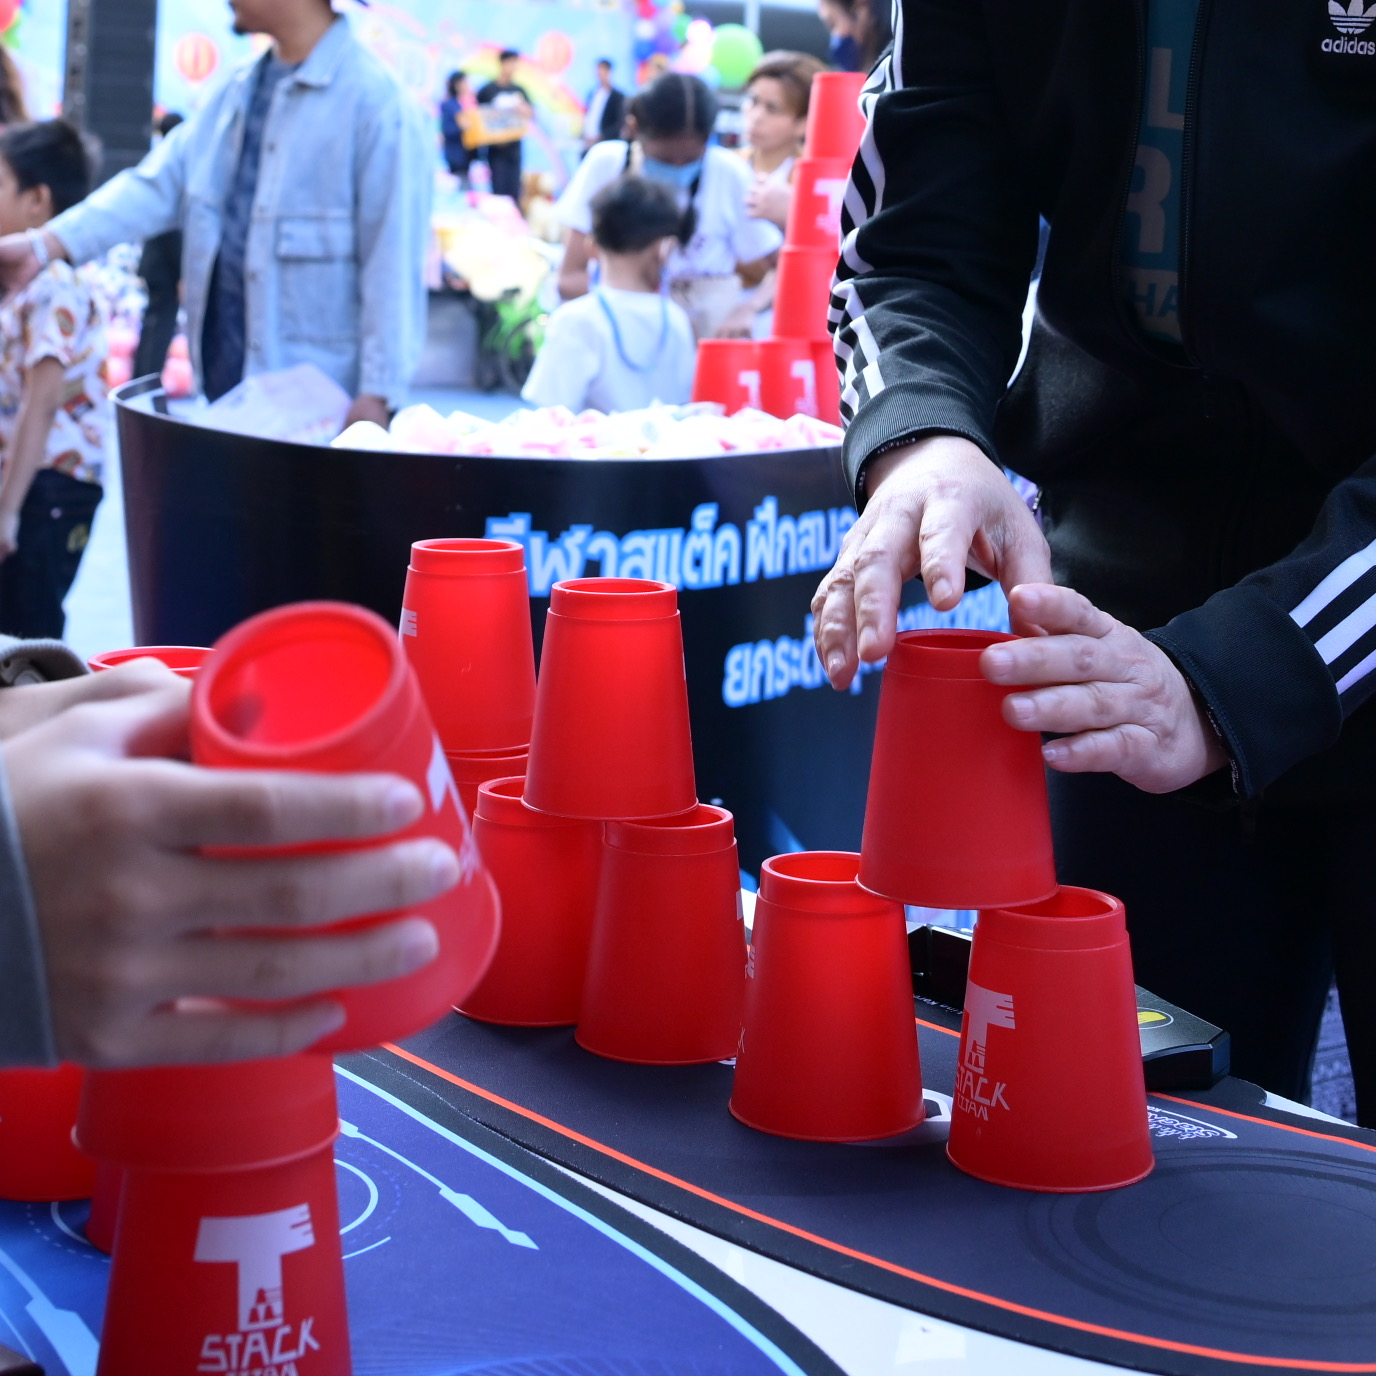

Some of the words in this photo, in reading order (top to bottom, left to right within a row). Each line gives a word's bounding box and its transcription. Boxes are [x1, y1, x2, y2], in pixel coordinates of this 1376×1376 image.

[1321, 36, 1376, 55] adidas
[485, 503, 740, 596] ีฬาสแต็ค
[197, 1316, 321, 1373] STACK
